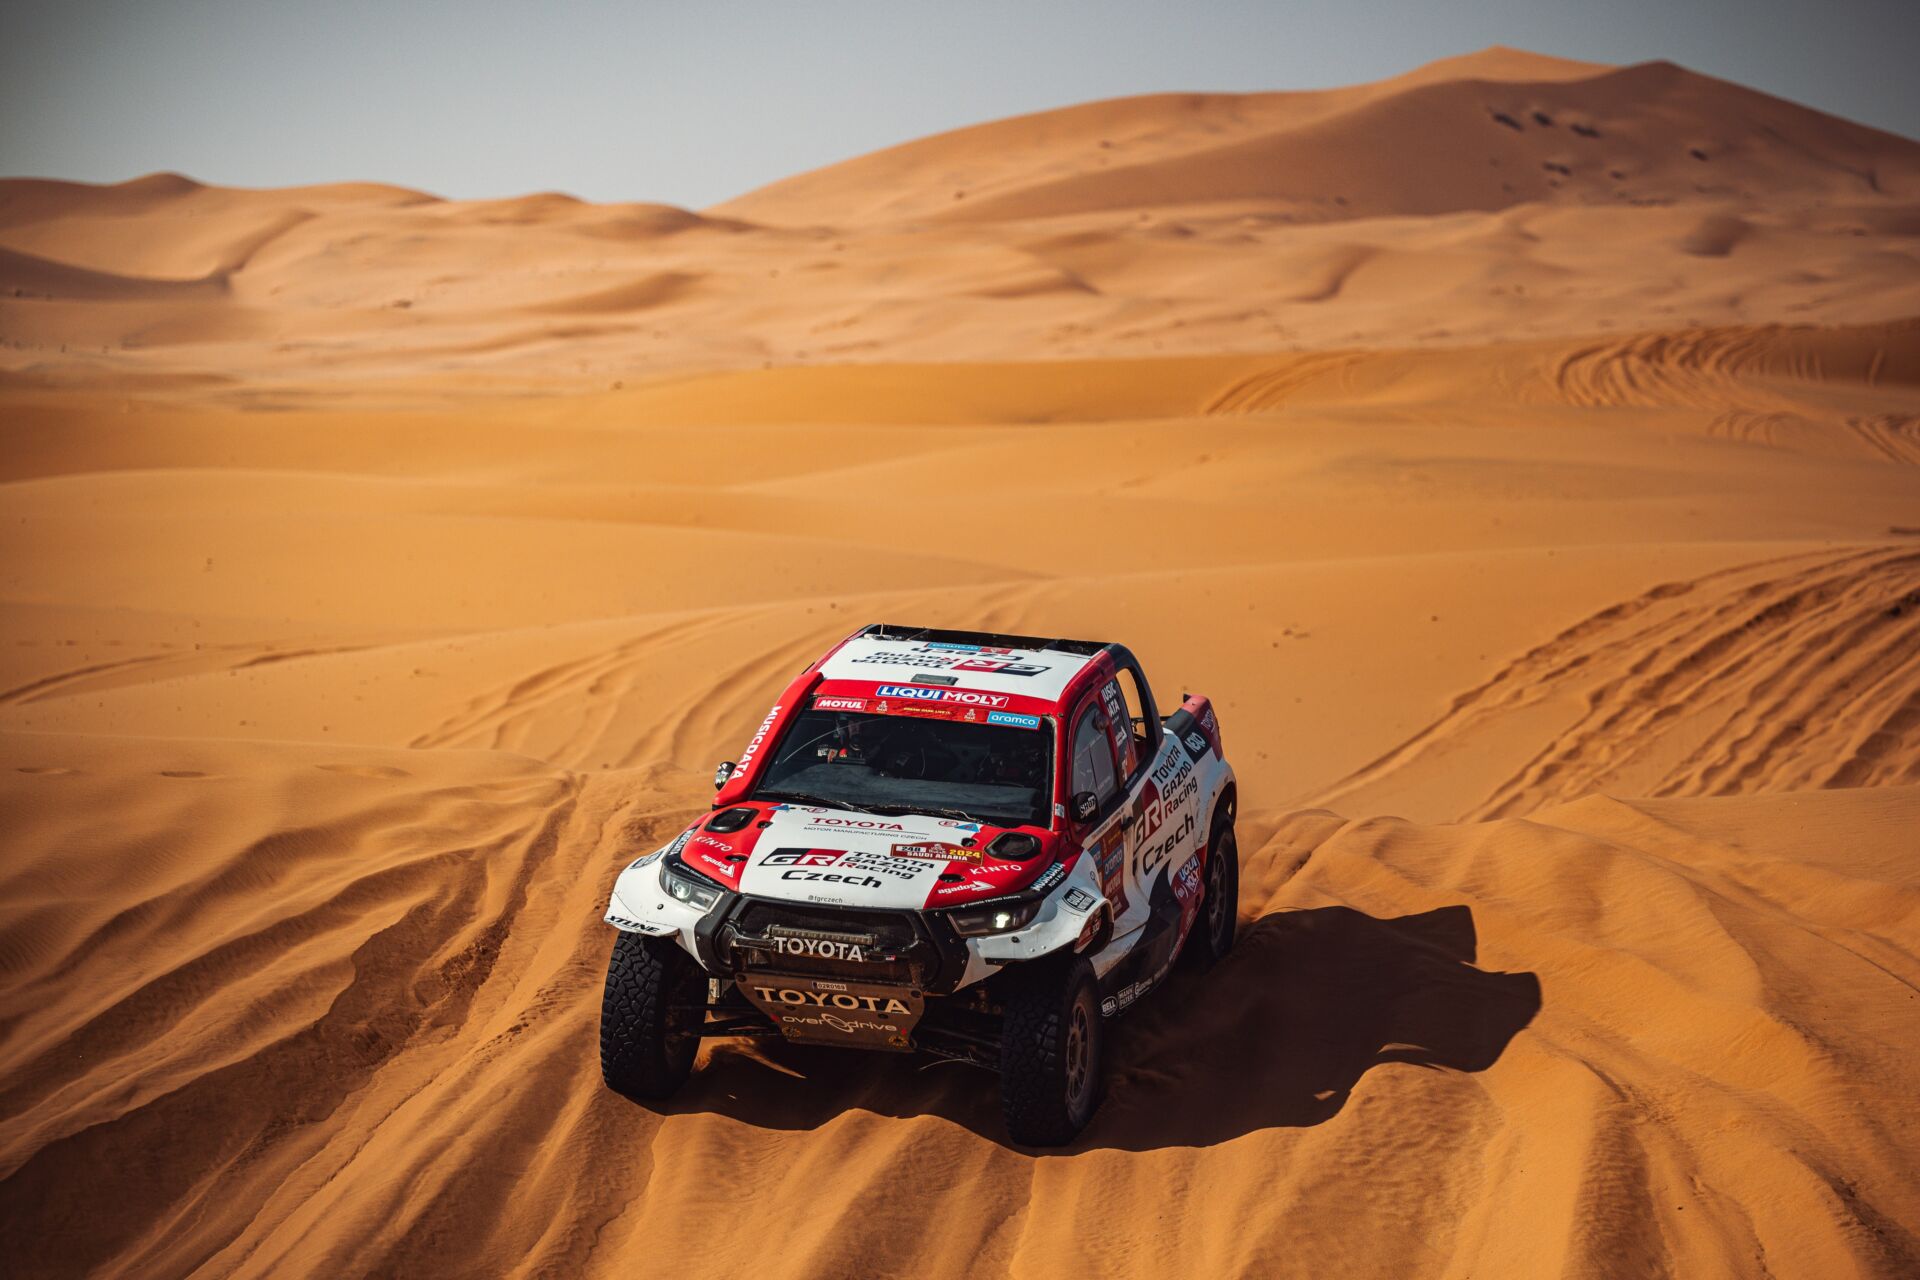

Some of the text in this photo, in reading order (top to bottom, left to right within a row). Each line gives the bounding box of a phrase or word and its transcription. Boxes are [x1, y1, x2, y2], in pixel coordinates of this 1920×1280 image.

[953, 659, 1050, 674] GR
[818, 699, 863, 710] MOTUL
[880, 686, 1007, 706] LIQUI MOLY
[991, 714, 1037, 728] aramco
[729, 705, 782, 779] MUSICDATA
[1152, 745, 1182, 784] TOYOTA
[1162, 761, 1192, 800] GAZOO
[1164, 777, 1198, 819] Racing
[812, 817, 903, 830] TOYOTA
[1135, 799, 1161, 845] GR
[834, 828, 899, 837] MANUFACTURING
[695, 836, 732, 852] KINTO
[1143, 813, 1194, 876] Czech
[759, 850, 843, 866] GR
[853, 851, 935, 869] TOYOTA
[935, 854, 968, 862] ARABIA
[950, 849, 981, 859] 2024
[838, 862, 915, 880] Racing
[845, 856, 922, 873] GAZOO
[970, 864, 1022, 875] KINTO
[1180, 854, 1200, 880] LIQUI
[781, 869, 882, 888] Czech
[938, 883, 977, 895] agados
[609, 915, 660, 933] XTLINE
[774, 936, 864, 962] TOYOTA
[754, 986, 912, 1015] TOYOTA
[1102, 1000, 1116, 1013] BELL
